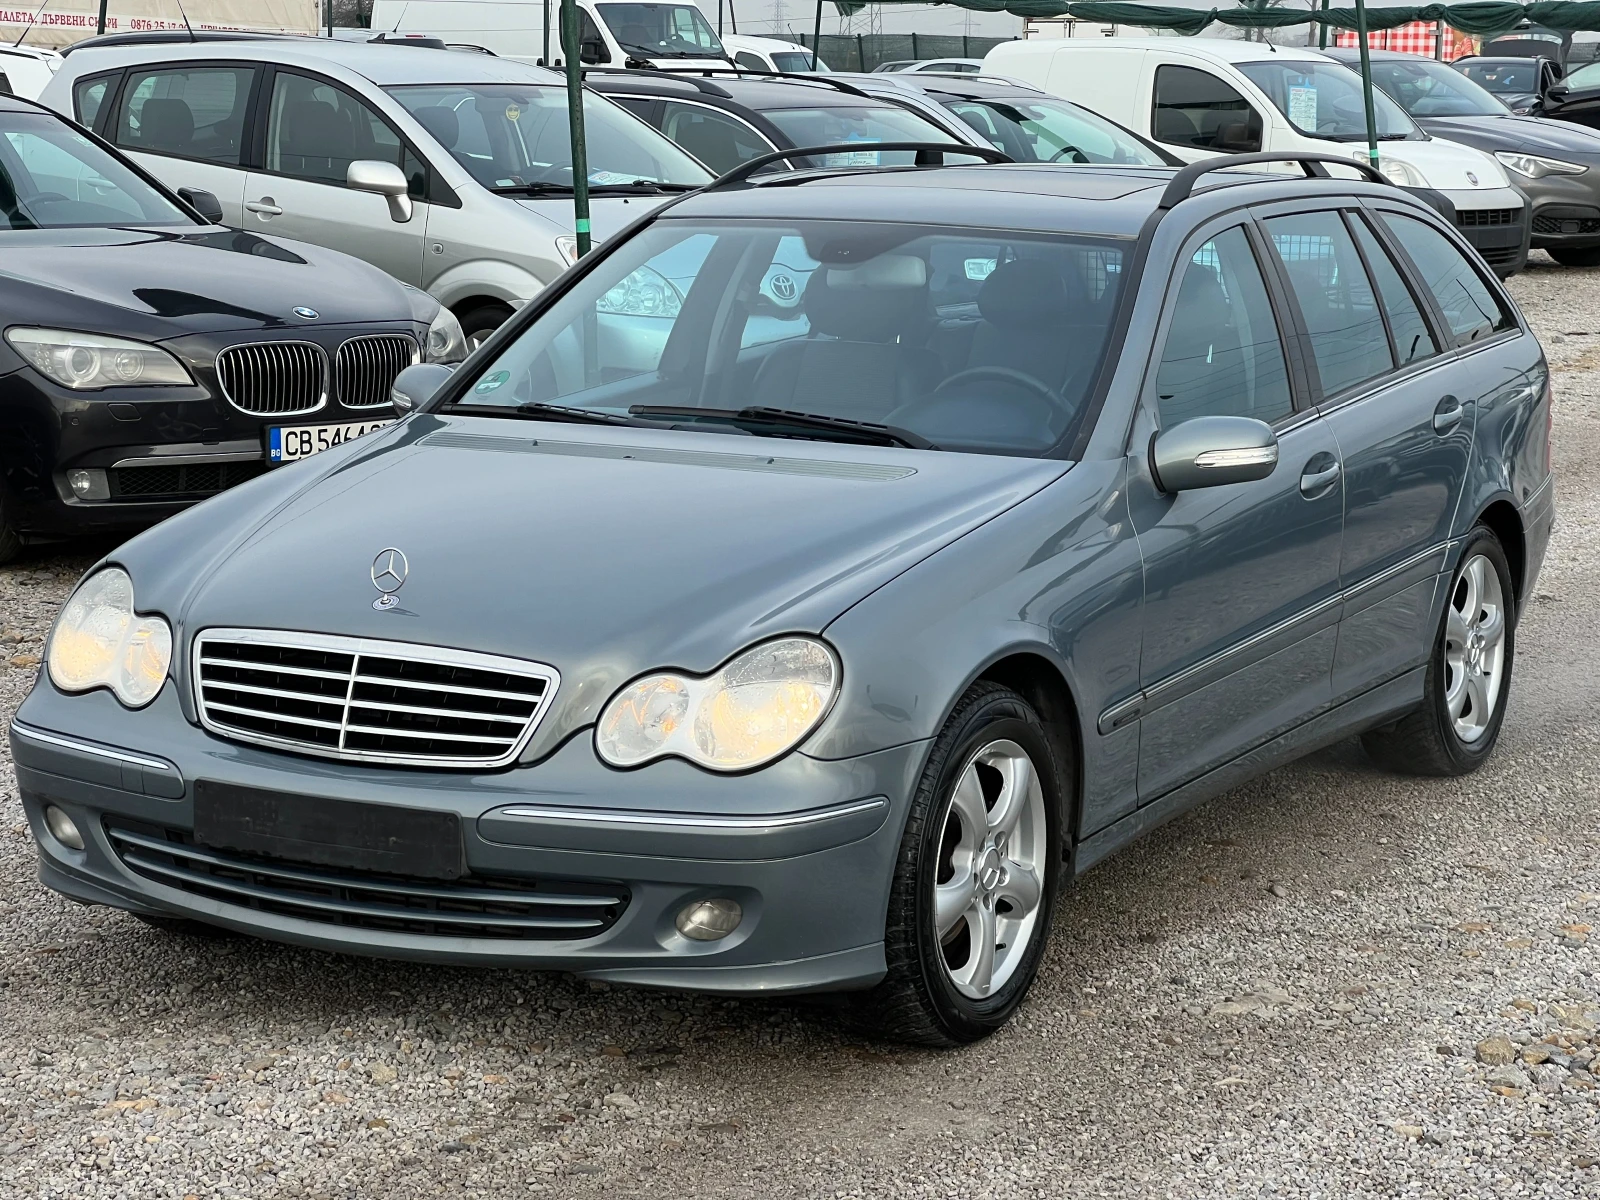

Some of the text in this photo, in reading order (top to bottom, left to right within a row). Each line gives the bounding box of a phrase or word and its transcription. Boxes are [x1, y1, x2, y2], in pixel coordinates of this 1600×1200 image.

[41, 13, 86, 27] ДЪРВЕНИ
[130, 18, 152, 30] 0876
[285, 430, 312, 456] CB
[270, 449, 281, 457] BG
